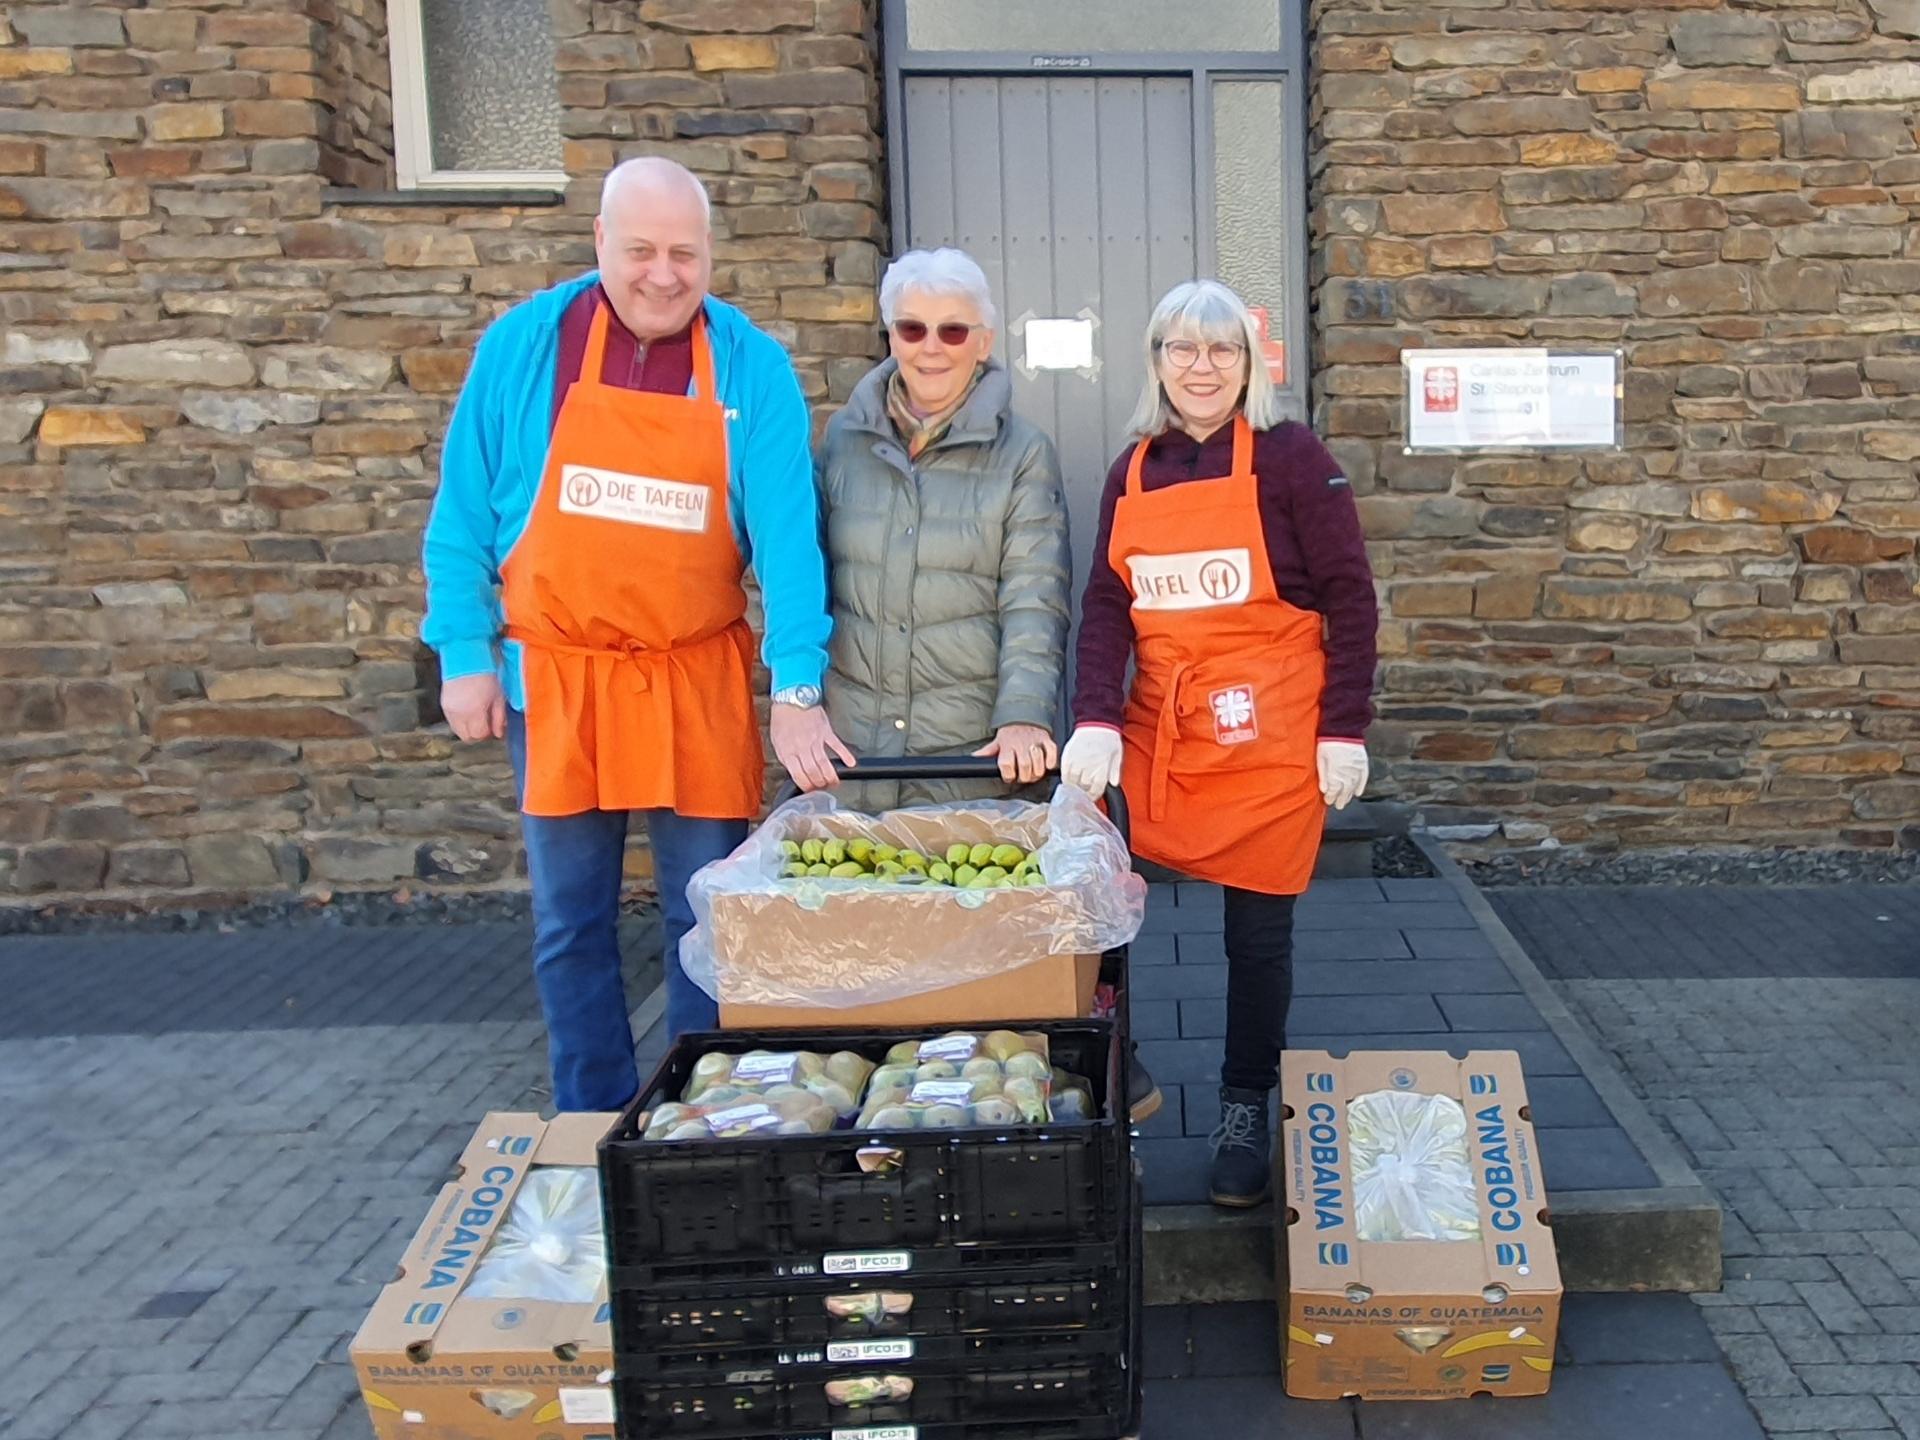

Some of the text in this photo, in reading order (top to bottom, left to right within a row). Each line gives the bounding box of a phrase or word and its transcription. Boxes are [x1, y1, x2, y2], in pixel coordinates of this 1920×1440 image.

[607, 480, 636, 502] DIE
[644, 486, 704, 512] TAFELN
[1307, 1103, 1344, 1230] COBANA
[1475, 1104, 1522, 1231] COBANA
[420, 1166, 515, 1290] COBANA
[860, 1256, 890, 1267] IFCO
[1303, 1305, 1544, 1319] BANANAS OF GUATEMALA
[863, 1345, 892, 1355] IFCO
[367, 1366, 464, 1377] BANANAS
[471, 1366, 494, 1376] OF
[868, 1429, 897, 1439] IFCO
